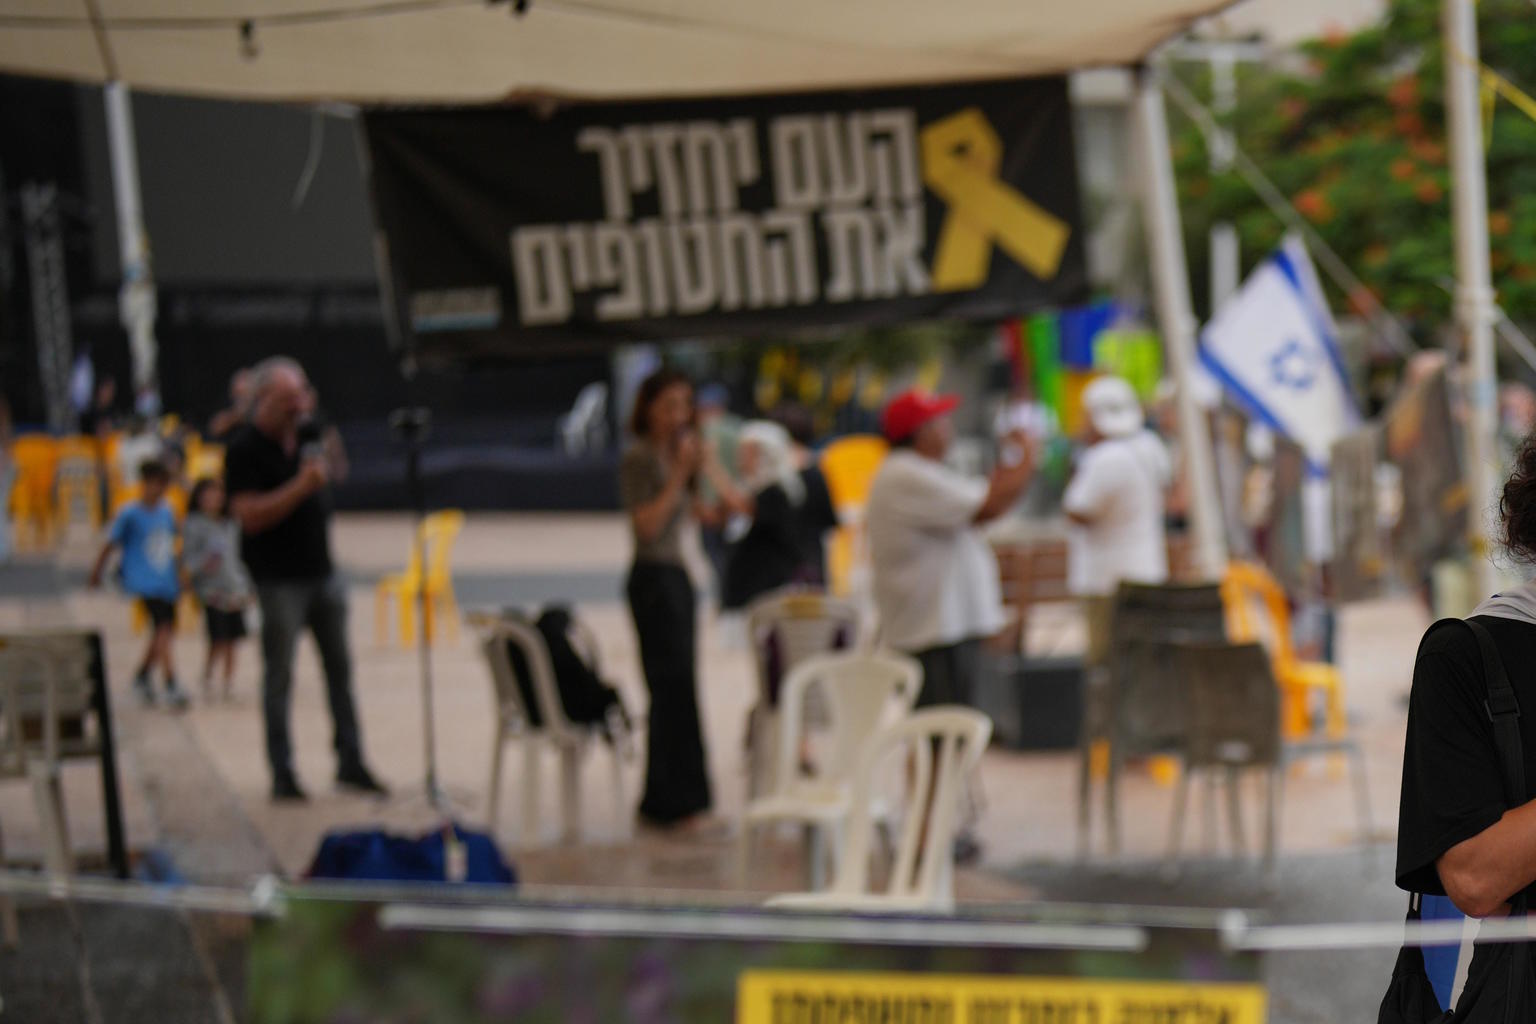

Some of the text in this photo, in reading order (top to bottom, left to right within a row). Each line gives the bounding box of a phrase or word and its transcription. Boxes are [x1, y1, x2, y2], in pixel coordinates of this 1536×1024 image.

[577, 111, 920, 224] העם יחזיר
[511, 211, 818, 324] החטופים
[823, 207, 932, 298] את
